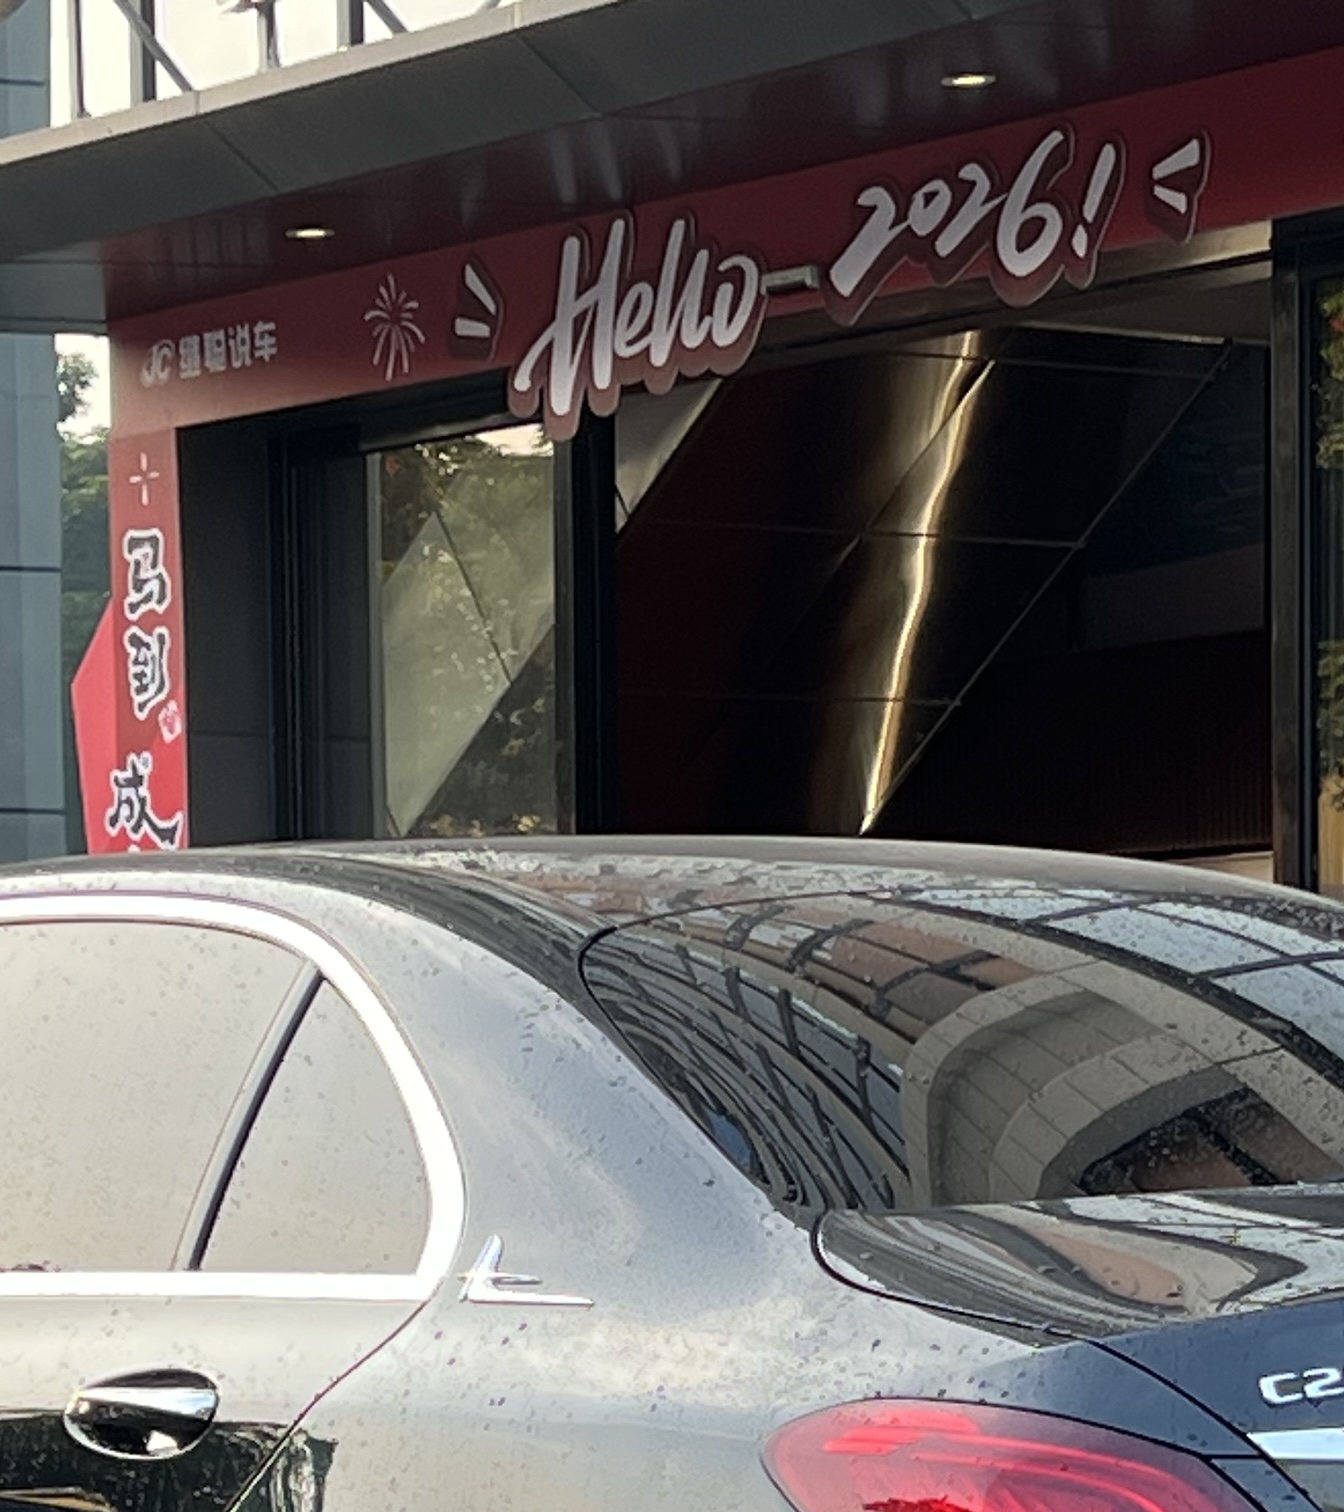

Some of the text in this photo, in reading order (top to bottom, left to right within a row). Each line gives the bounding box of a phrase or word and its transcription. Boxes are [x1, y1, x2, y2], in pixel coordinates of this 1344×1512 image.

[513, 130, 1116, 416] Hello 2026!
[106, 528, 184, 852] 马到成
